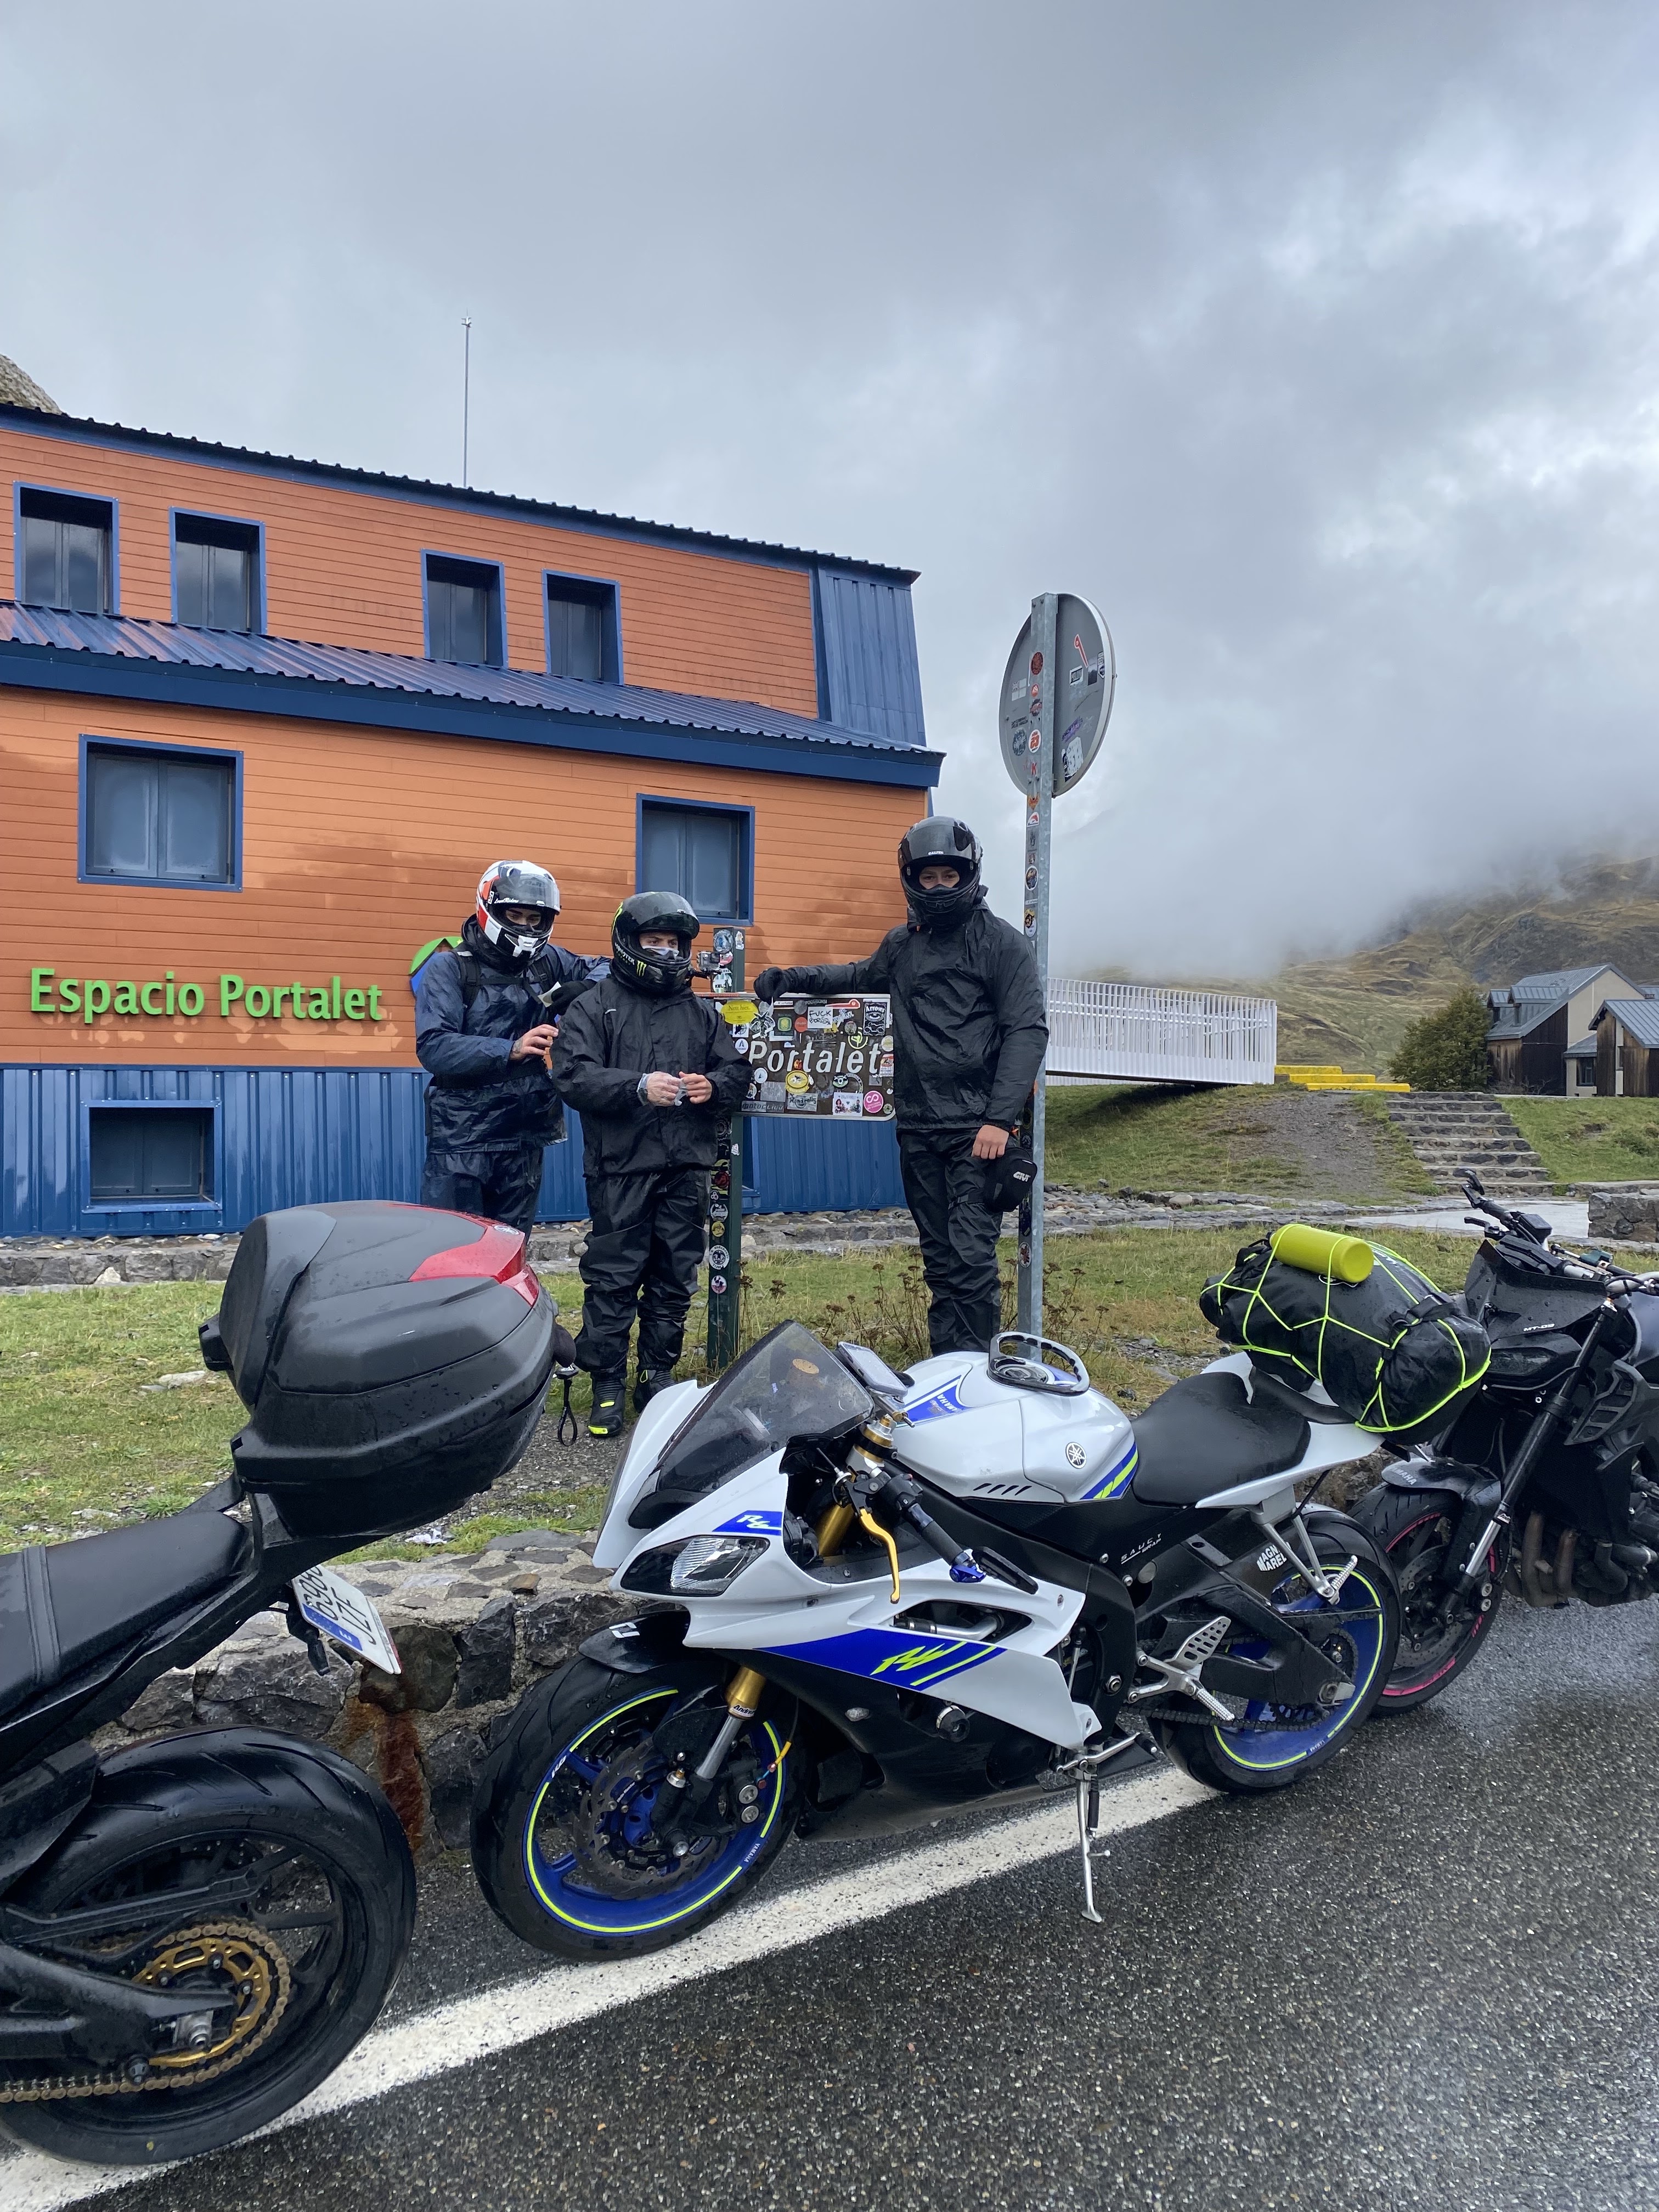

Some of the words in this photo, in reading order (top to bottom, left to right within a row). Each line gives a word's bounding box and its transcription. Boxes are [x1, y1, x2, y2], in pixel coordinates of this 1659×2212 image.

[31, 967, 205, 1024] Espacio
[220, 974, 382, 1021] Portalet
[749, 1041, 881, 1073] Portalet
[1523, 1323, 1555, 1331] MT-09
[330, 1587, 377, 1645] JZF
